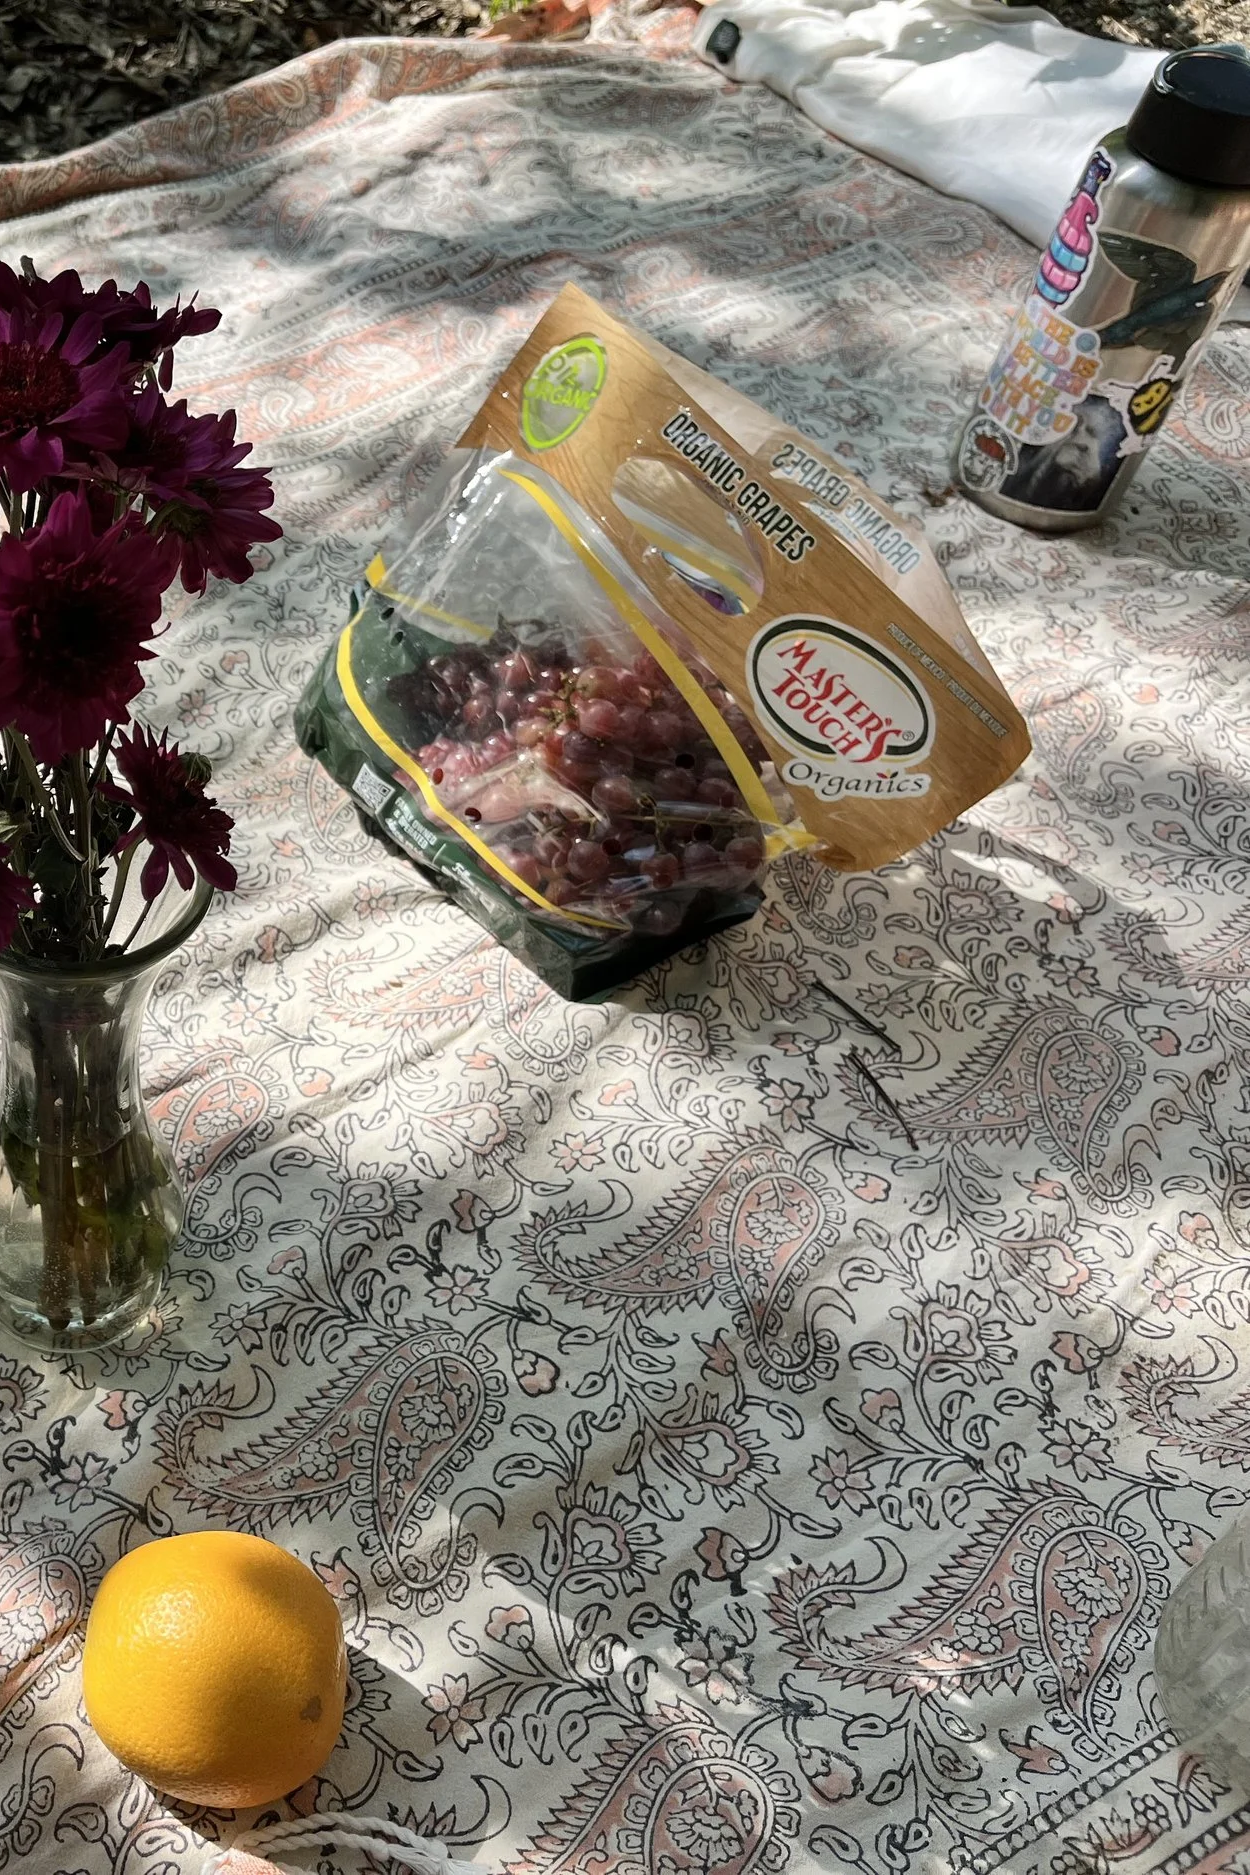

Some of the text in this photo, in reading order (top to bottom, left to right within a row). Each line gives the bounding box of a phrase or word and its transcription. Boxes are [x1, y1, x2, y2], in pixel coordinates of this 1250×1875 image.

[1012, 340, 1088, 398] BETTER
[1071, 354, 1100, 379] IS
[662, 412, 745, 493] ORGANIC
[736, 482, 816, 562] GRAPES
[772, 668, 862, 756] TOUCH
[777, 640, 903, 763] MASTER'S
[789, 762, 924, 796] Organics
[398, 815, 430, 850] OPERATED
[412, 819, 437, 846] OWNED
